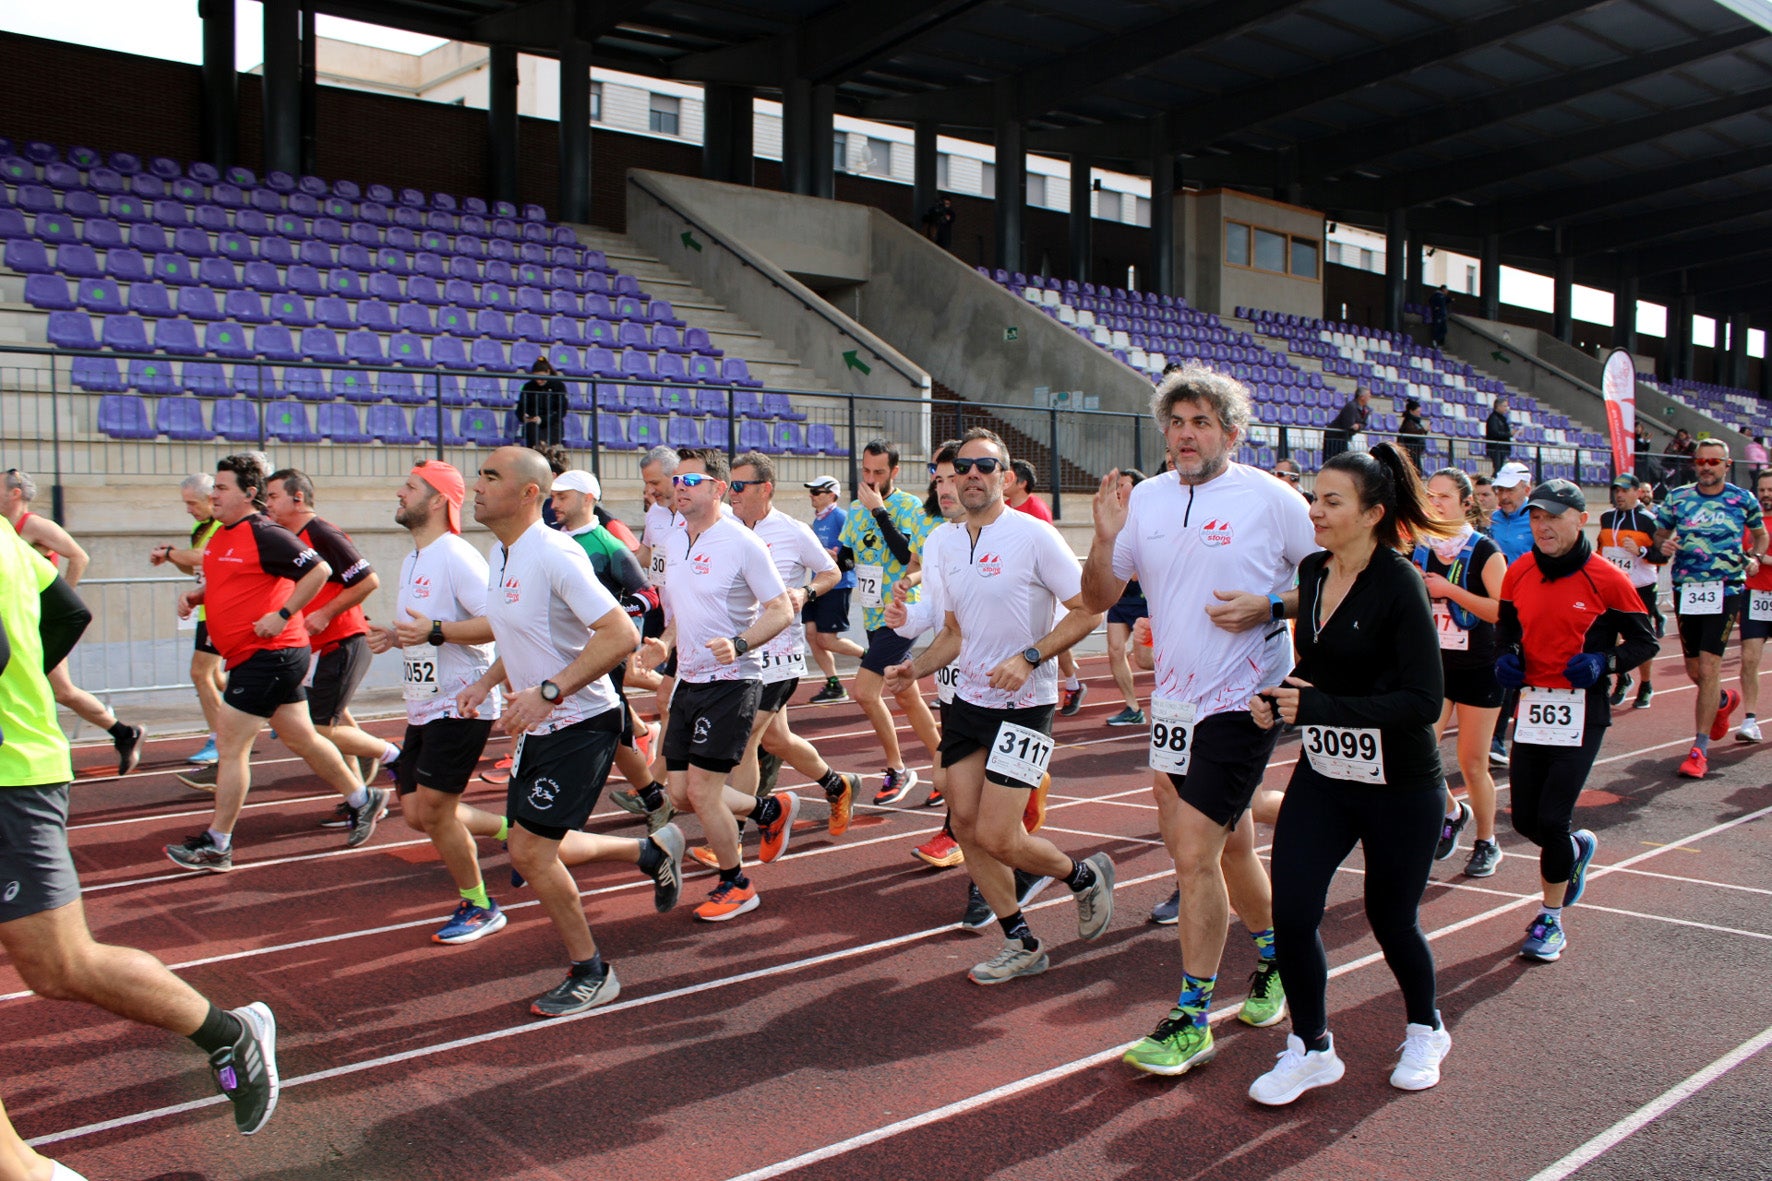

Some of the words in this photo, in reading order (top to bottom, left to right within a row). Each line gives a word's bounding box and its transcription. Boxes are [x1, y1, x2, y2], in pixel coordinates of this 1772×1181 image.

[1607, 556, 1631, 570] 114
[1688, 591, 1716, 604] 343
[403, 661, 436, 682] 052
[1528, 704, 1572, 726] 563
[998, 731, 1050, 767] 3117
[1307, 726, 1377, 761] 3099
